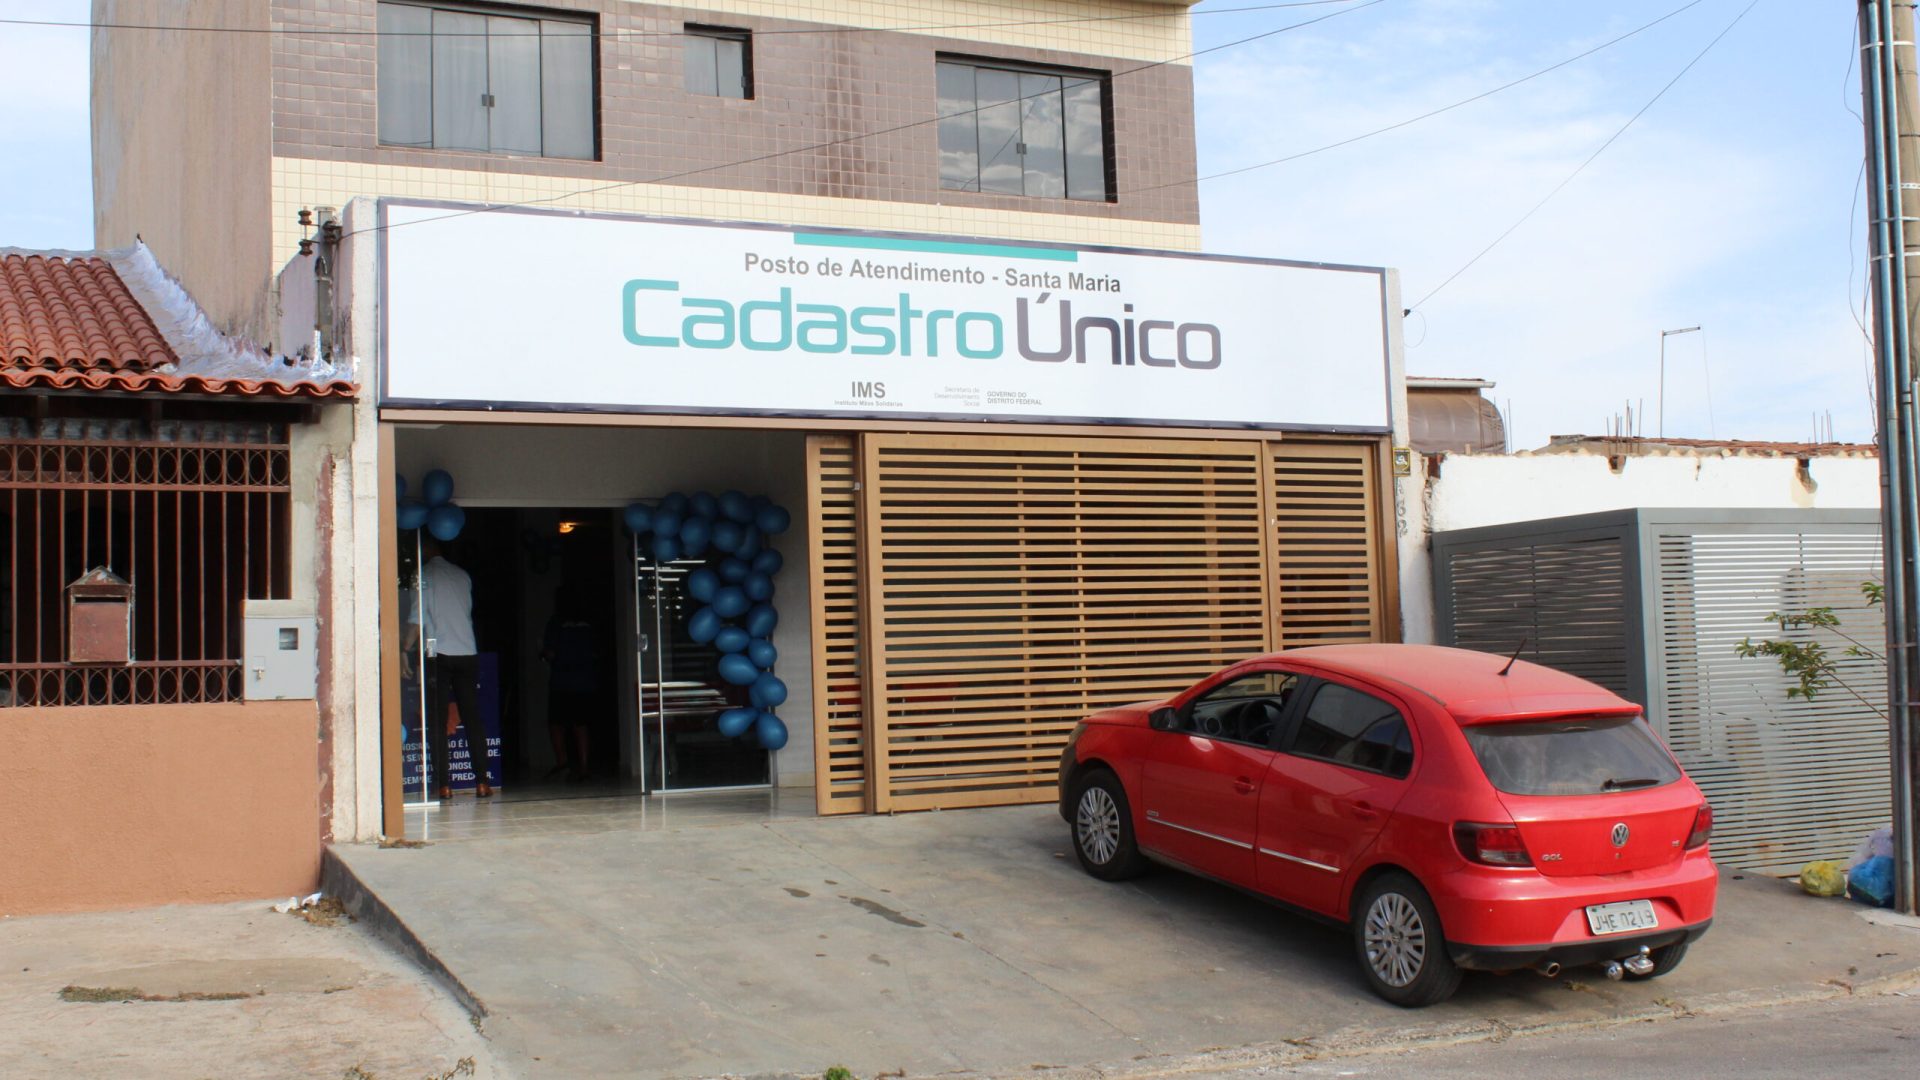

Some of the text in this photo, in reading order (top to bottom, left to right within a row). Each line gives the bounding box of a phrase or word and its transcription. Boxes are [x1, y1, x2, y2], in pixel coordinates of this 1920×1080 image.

[744, 252, 810, 276] Posto
[816, 257, 843, 277] de
[849, 258, 985, 285] Atendimento
[1004, 267, 1062, 290] Santa
[1068, 271, 1121, 293] Maria
[621, 278, 1223, 371] Cadastro Único
[851, 381, 886, 399] IMS
[1541, 853, 1563, 861] GOL
